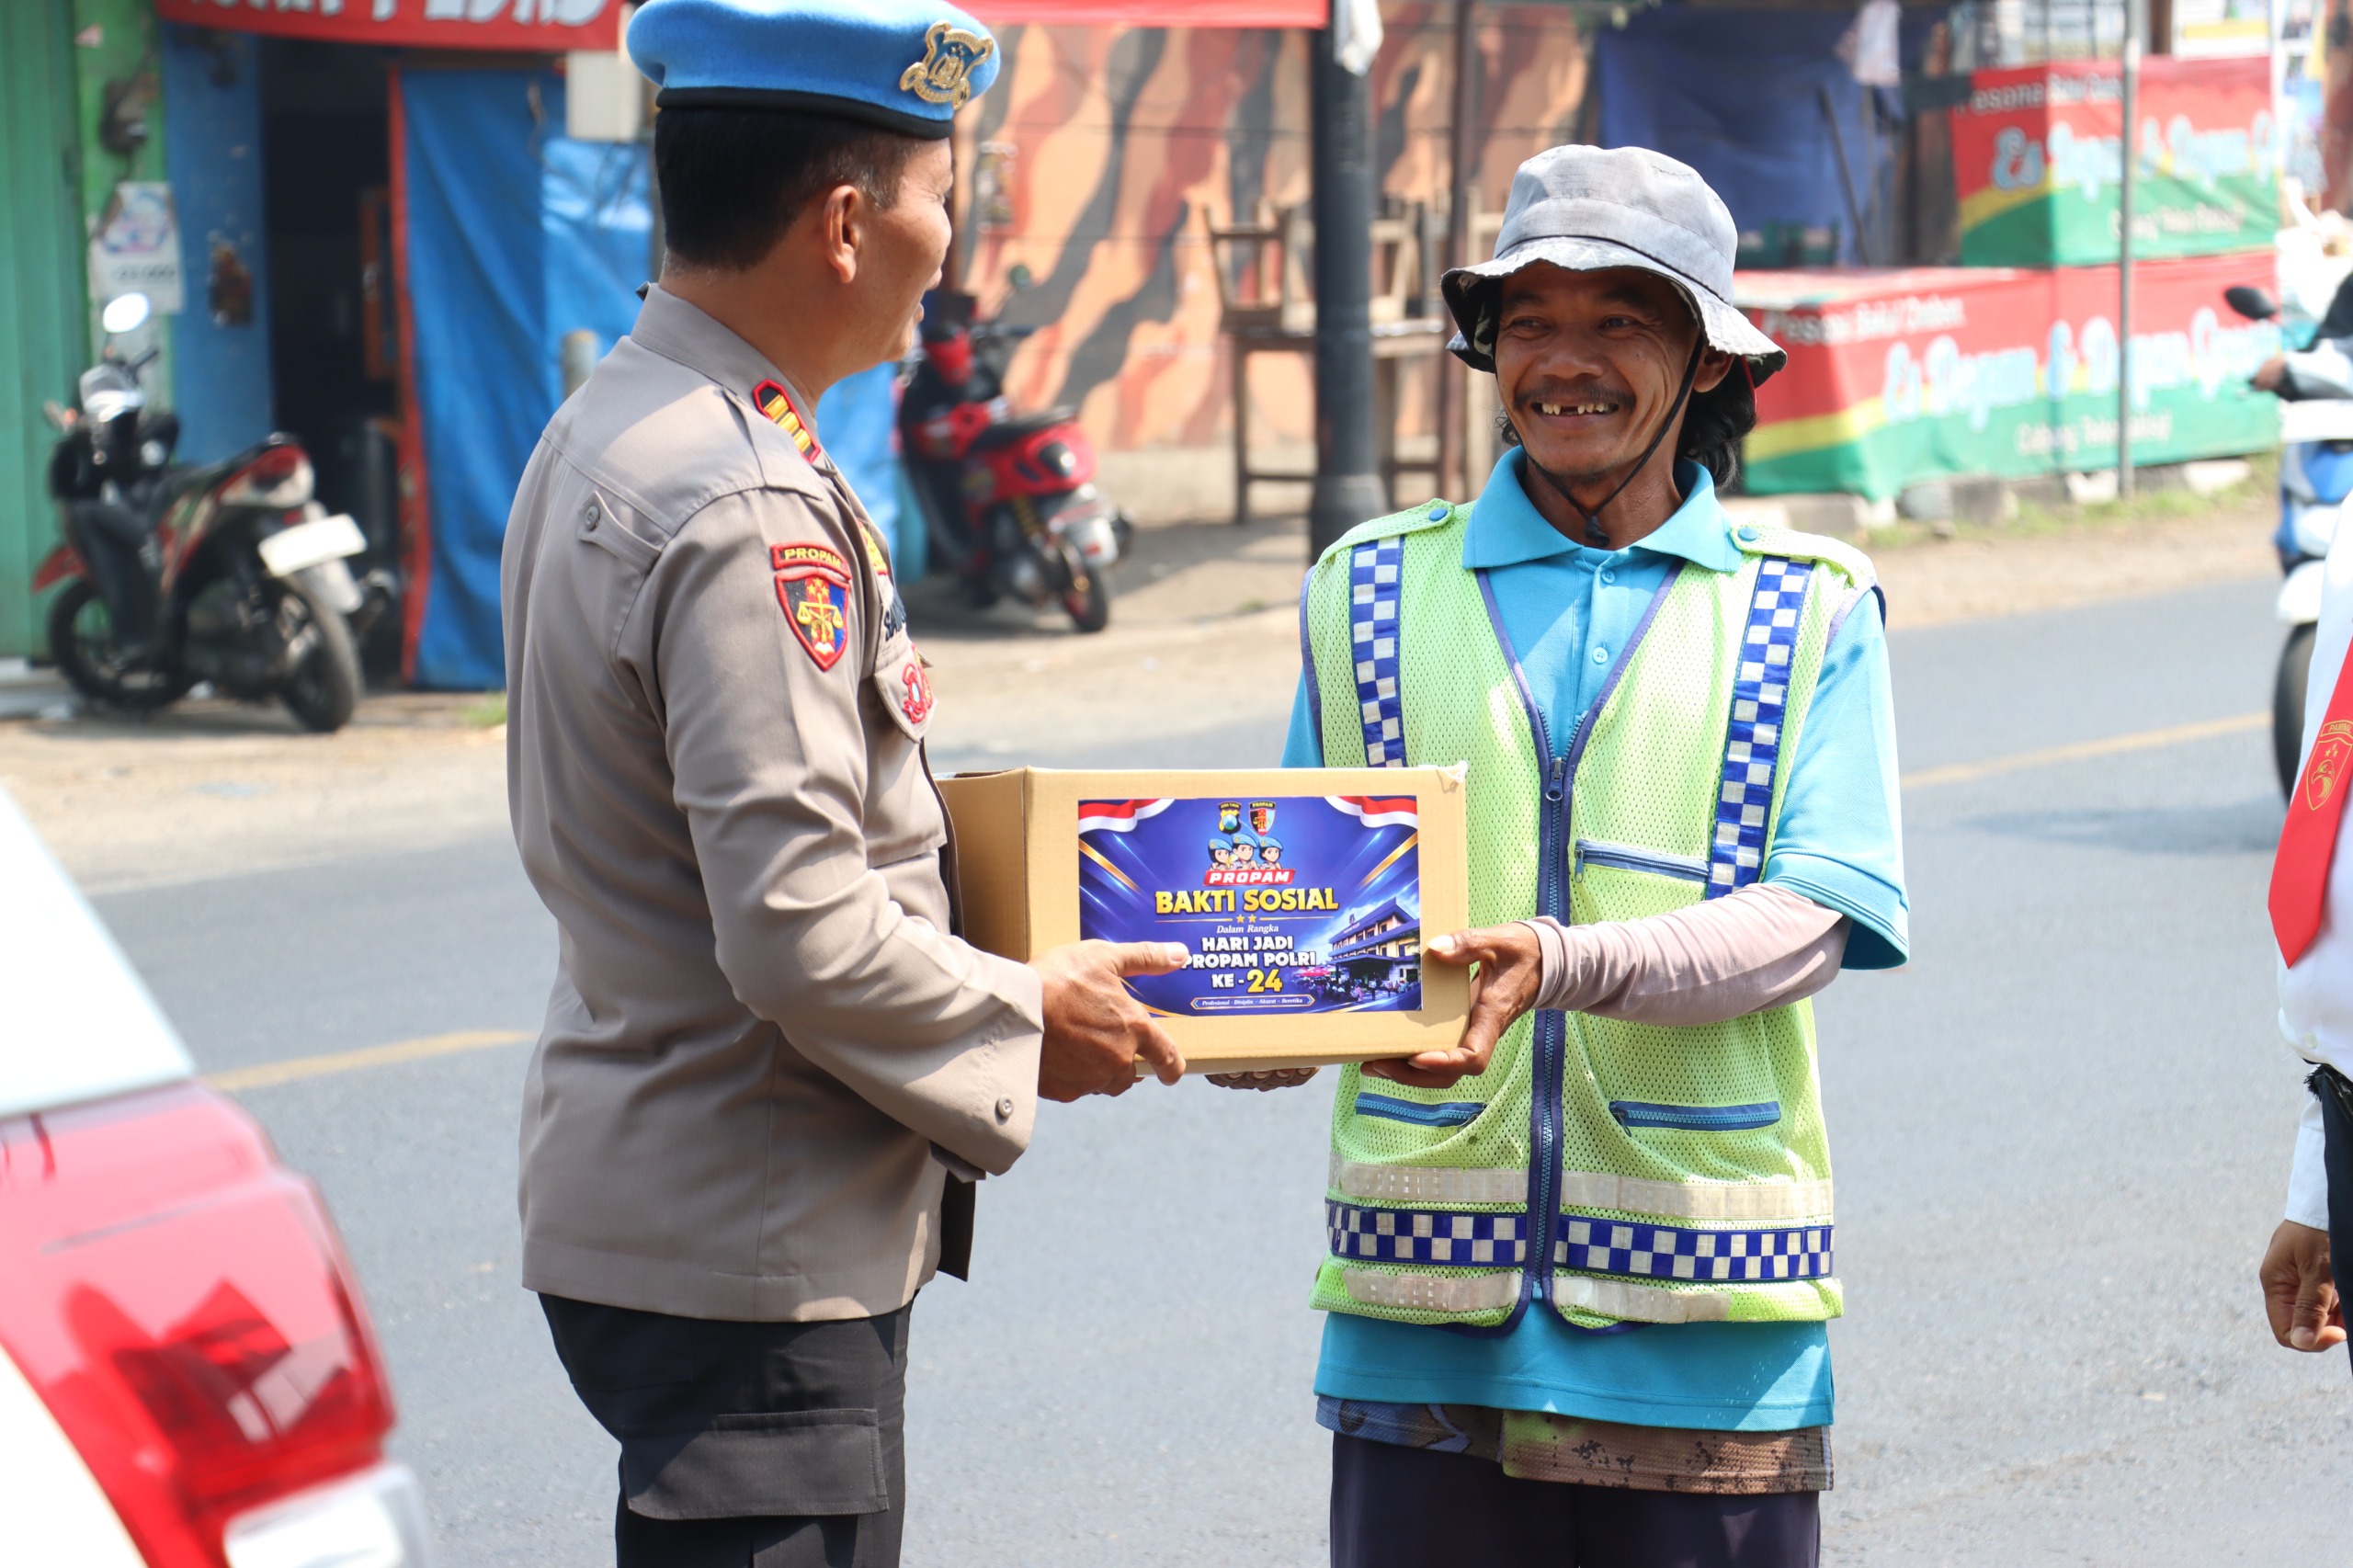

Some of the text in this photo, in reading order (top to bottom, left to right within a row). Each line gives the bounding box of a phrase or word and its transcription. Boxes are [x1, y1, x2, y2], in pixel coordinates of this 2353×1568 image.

[784, 547, 842, 568] PROPAM
[1209, 871, 1290, 883] PROPAM
[1155, 887, 1339, 914] BAKTI SOSIAL
[1216, 924, 1279, 935] Dalam Rangka
[1201, 935, 1293, 952] HARI JADI
[1264, 951, 1316, 967] POLRI
[1211, 972, 1234, 988] KE
